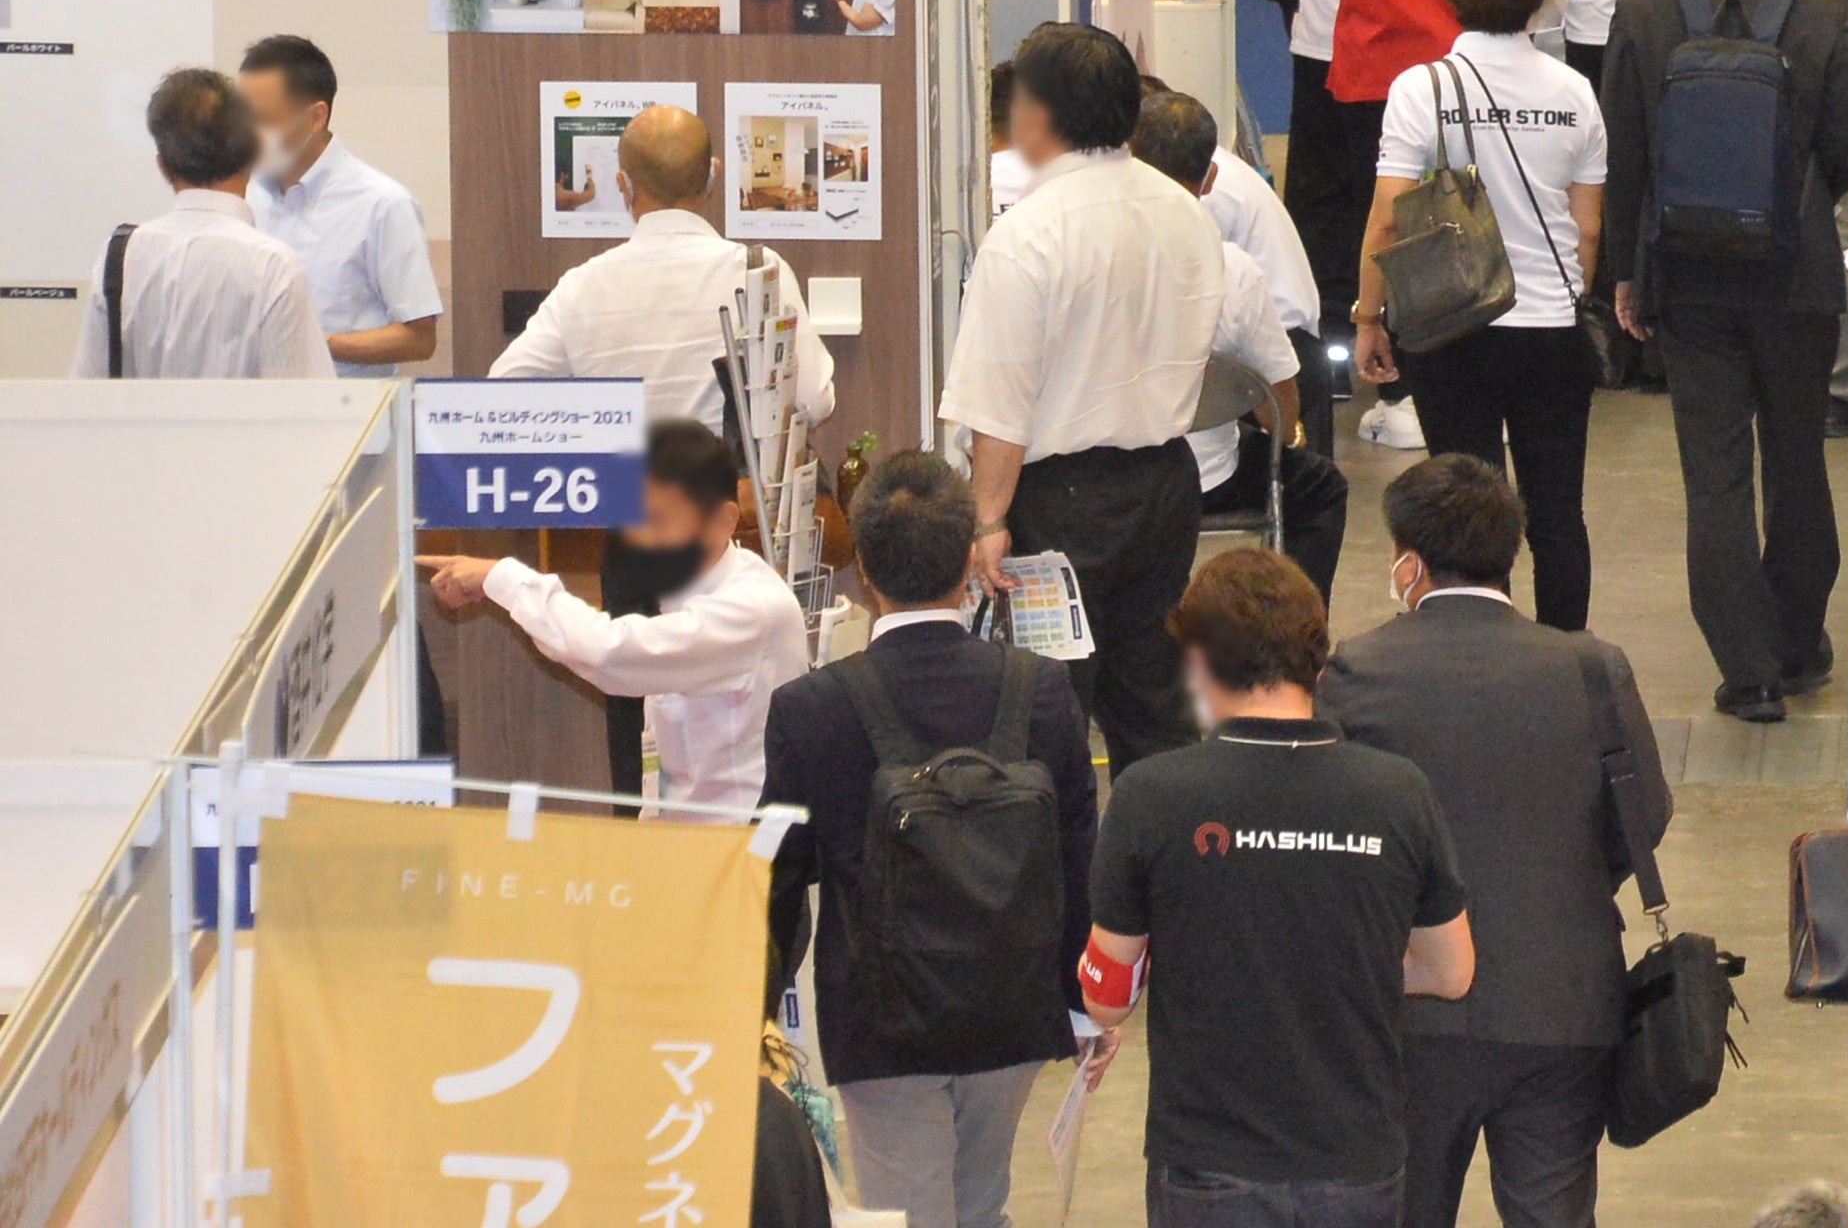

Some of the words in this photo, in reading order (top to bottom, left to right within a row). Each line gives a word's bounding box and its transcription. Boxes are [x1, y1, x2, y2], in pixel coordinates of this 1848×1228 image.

[1516, 109, 1577, 127] STONE
[466, 467, 599, 514] H-26
[1235, 829, 1383, 856] HASHILUS
[401, 868, 632, 909] FINE-MG
